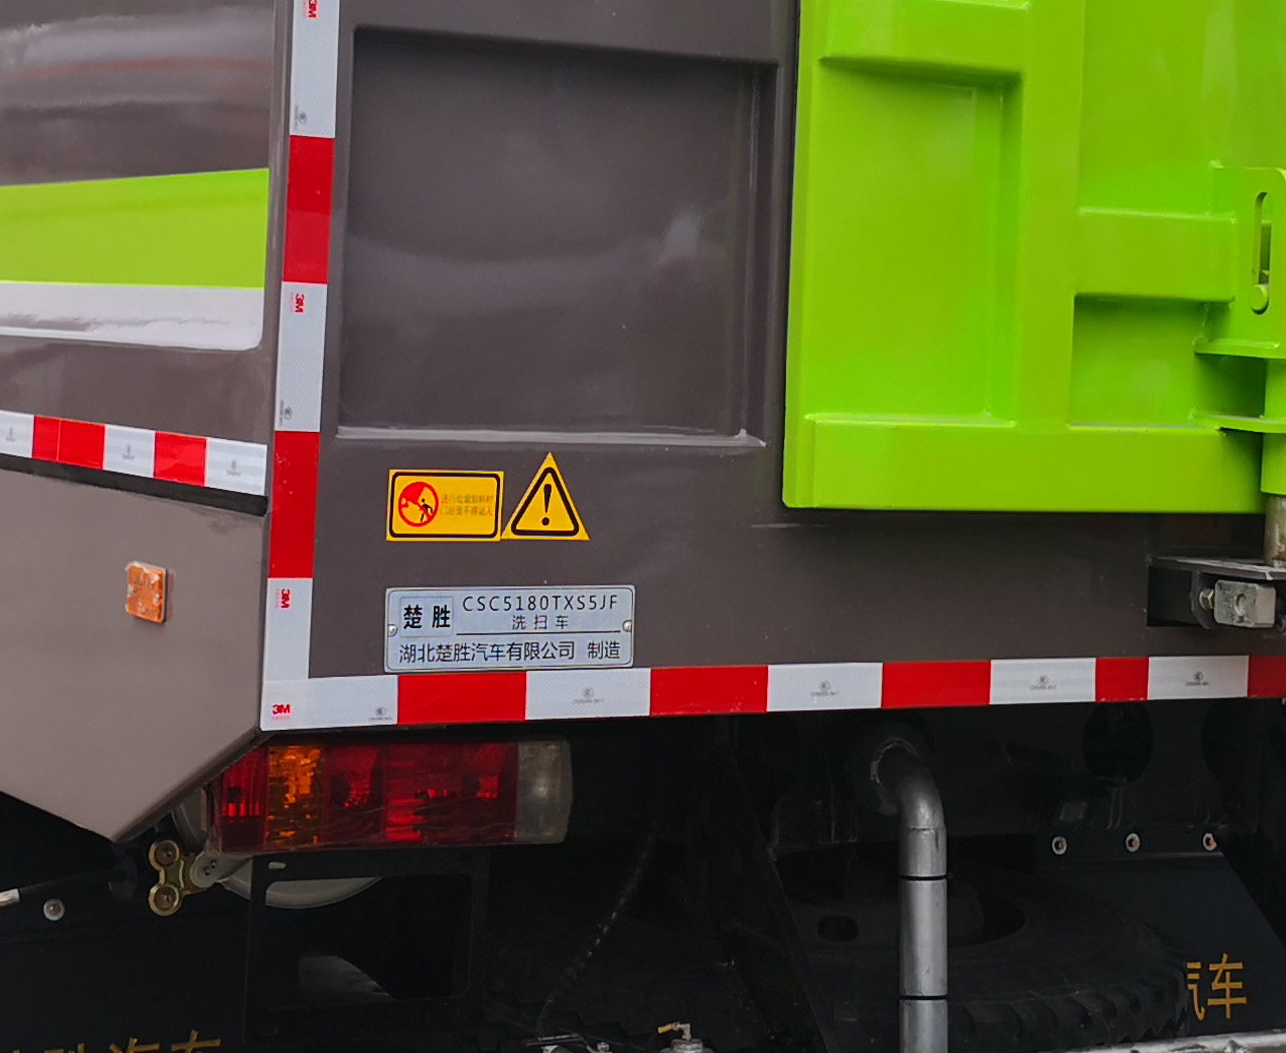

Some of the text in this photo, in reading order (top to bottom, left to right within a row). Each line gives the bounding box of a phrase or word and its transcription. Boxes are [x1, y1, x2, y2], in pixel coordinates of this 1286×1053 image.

[295, 293, 305, 313] 3M
[280, 588, 291, 610] 3M
[462, 595, 618, 612] CSC5180TXS5JF
[403, 604, 451, 629] 楚胜
[512, 615, 569, 631] 洗扫车
[399, 640, 620, 663] 湖北楚胜汽车有限公司 制造
[272, 704, 291, 715] 3M
